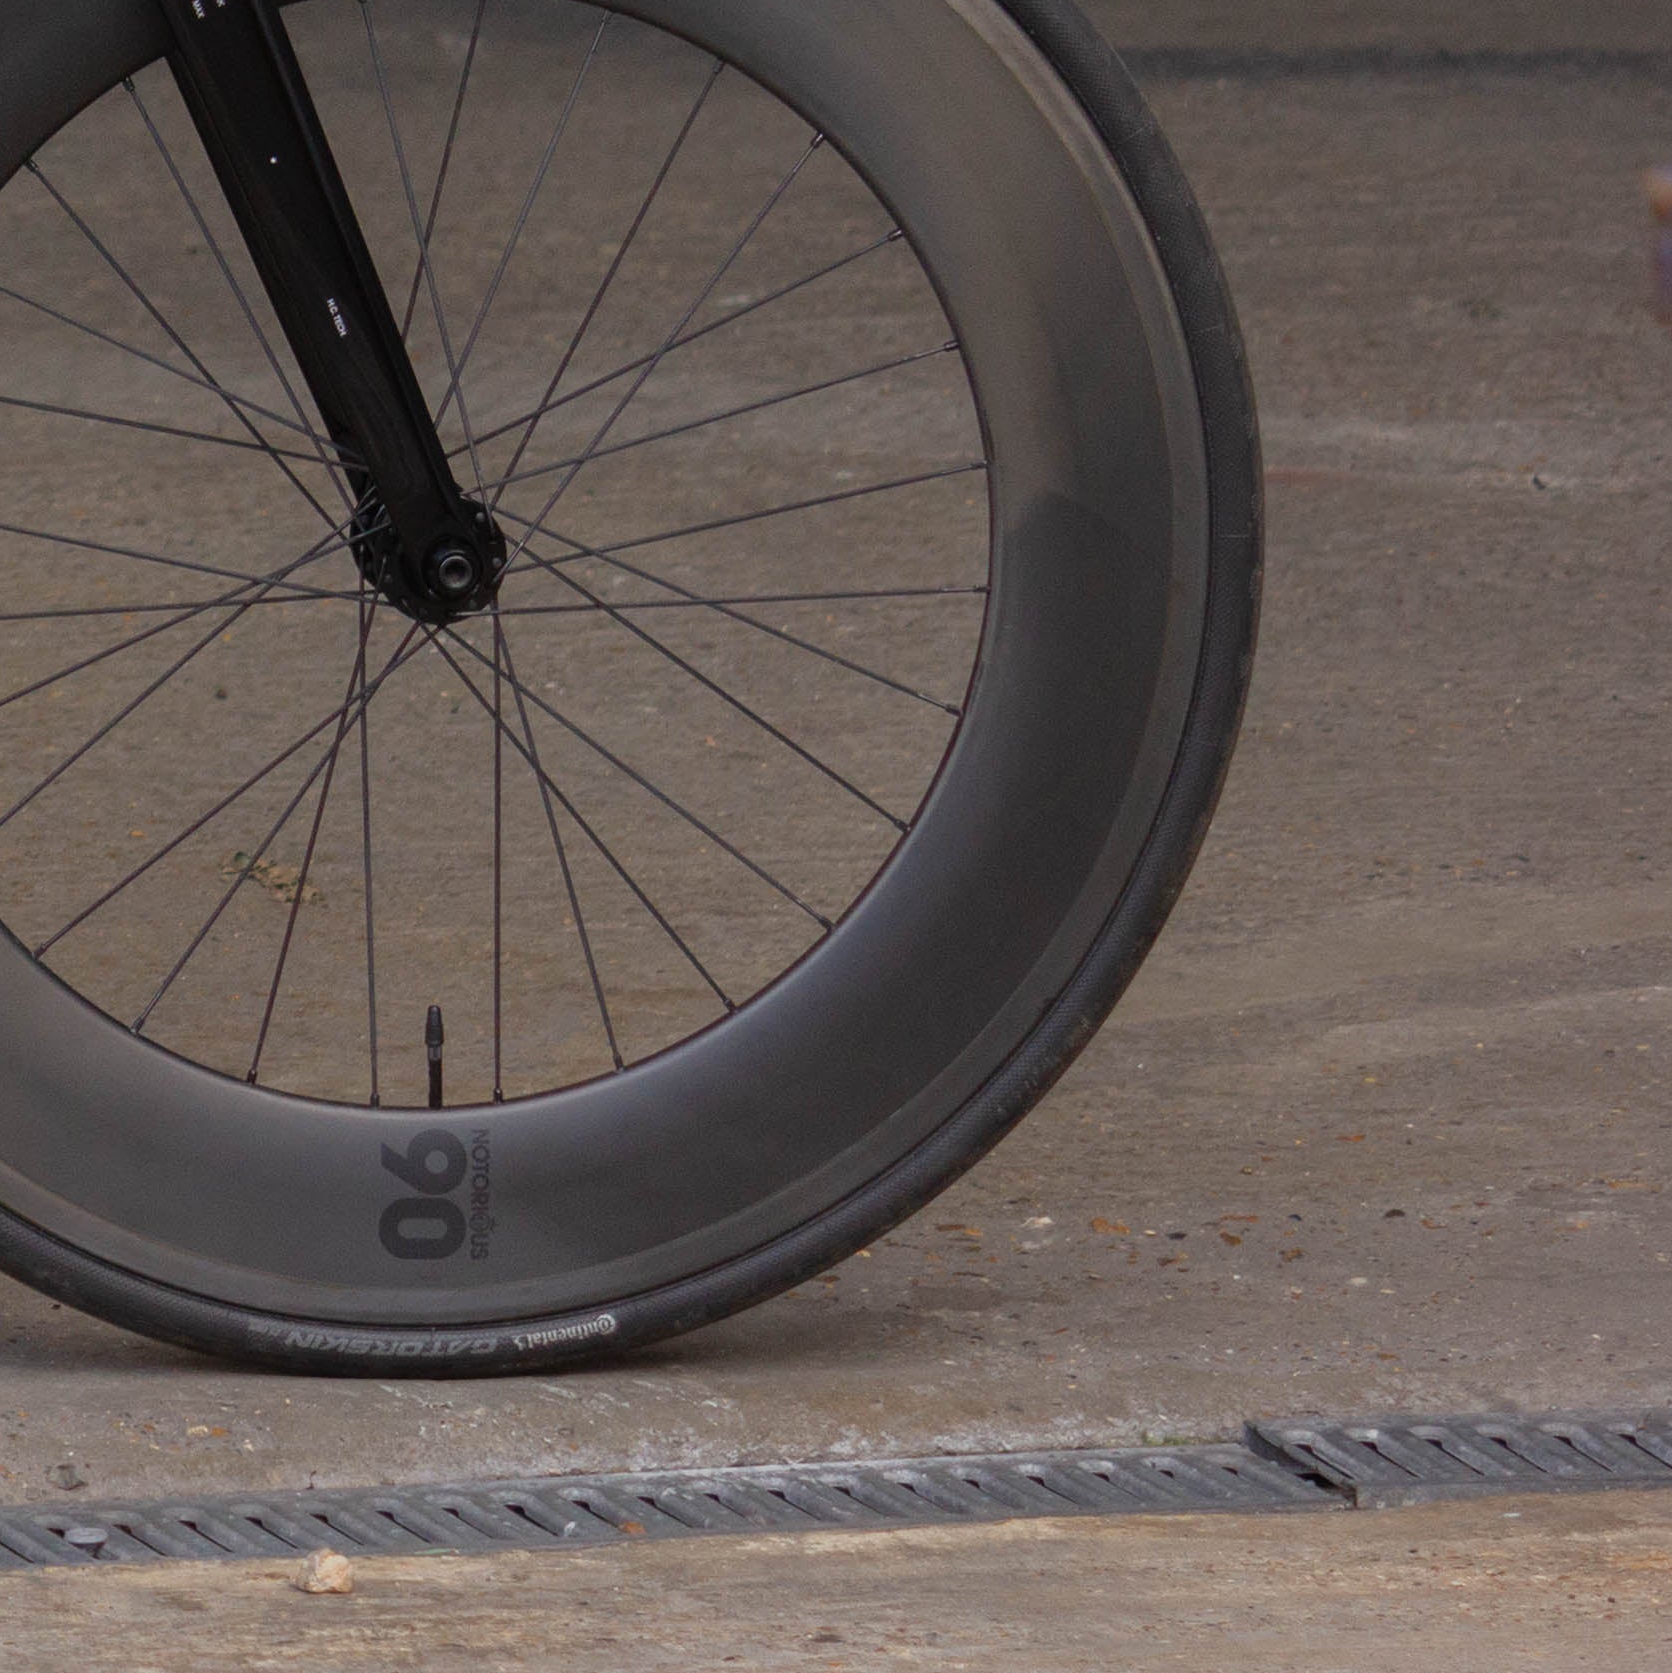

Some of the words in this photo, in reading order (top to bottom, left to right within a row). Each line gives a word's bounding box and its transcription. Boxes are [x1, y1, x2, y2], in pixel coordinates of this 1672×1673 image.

[378, 1129, 467, 1260] 90
[284, 1330, 500, 1355] GATORSKIN
[527, 1314, 616, 1348] Continental
